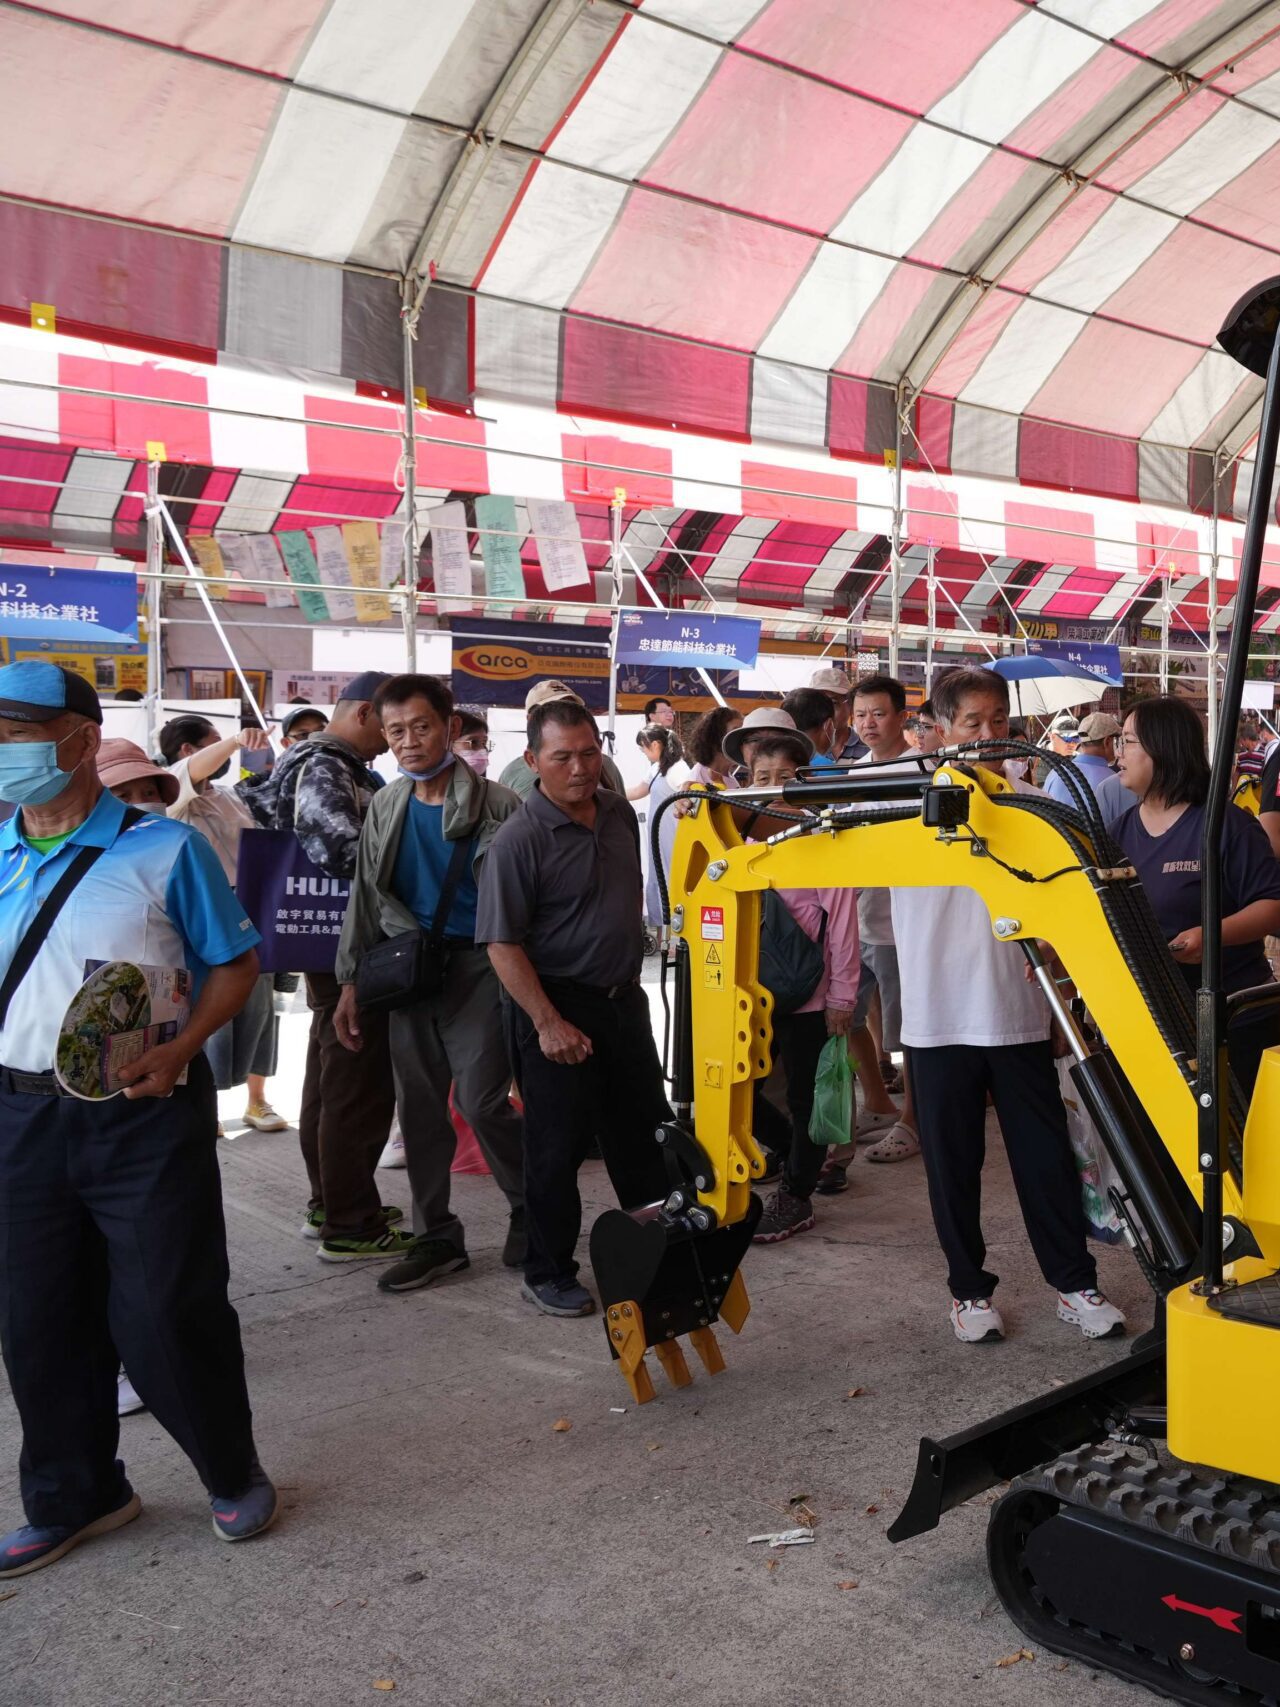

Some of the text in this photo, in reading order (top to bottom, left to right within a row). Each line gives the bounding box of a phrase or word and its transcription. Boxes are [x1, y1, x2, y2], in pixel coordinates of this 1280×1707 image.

[1, 601, 99, 622] 科技企業社
[681, 627, 700, 639] N-3
[638, 638, 737, 657] 忠達節能科技企業社
[477, 654, 528, 669] arca
[1068, 653, 1081, 661] N-4
[286, 876, 353, 896] HUL
